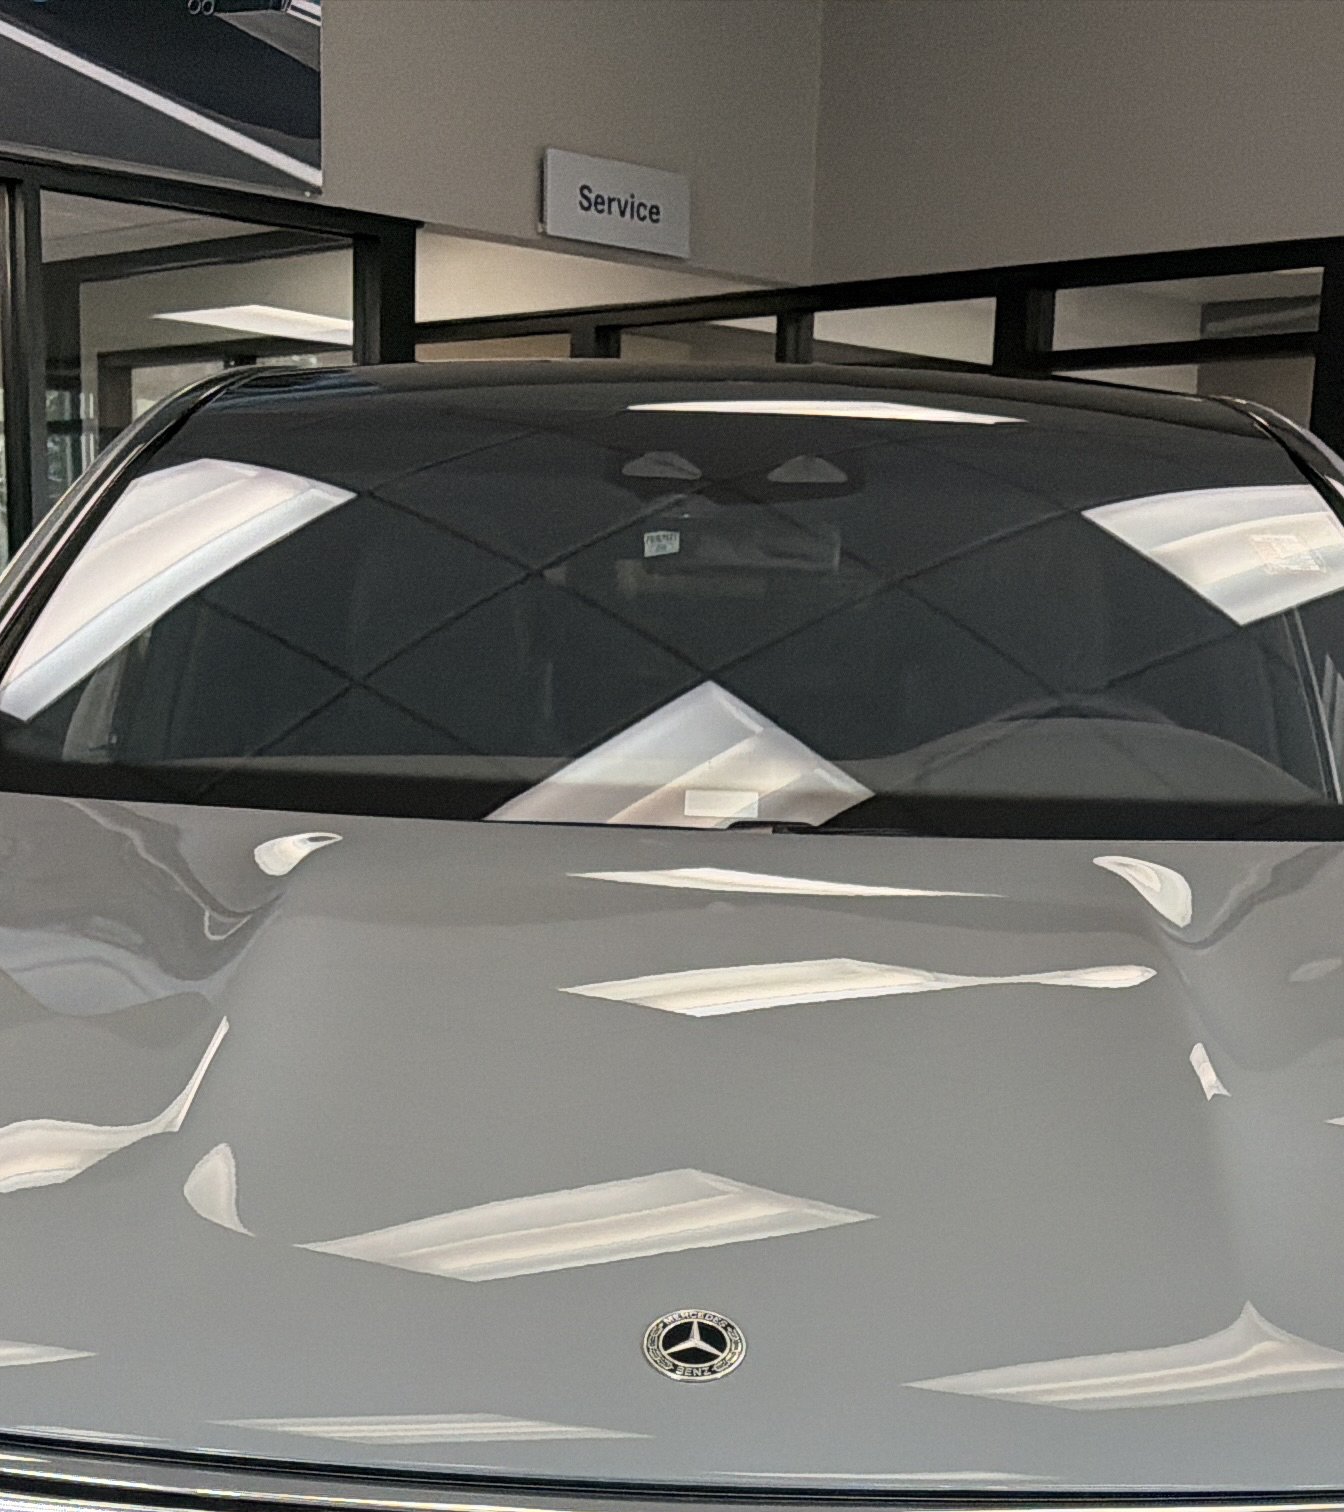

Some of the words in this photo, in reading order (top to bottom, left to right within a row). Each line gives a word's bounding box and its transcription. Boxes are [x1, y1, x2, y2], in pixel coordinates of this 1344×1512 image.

[578, 184, 661, 224] Service
[664, 1311, 729, 1328] MERCEDES
[674, 1366, 712, 1377] BENZ
